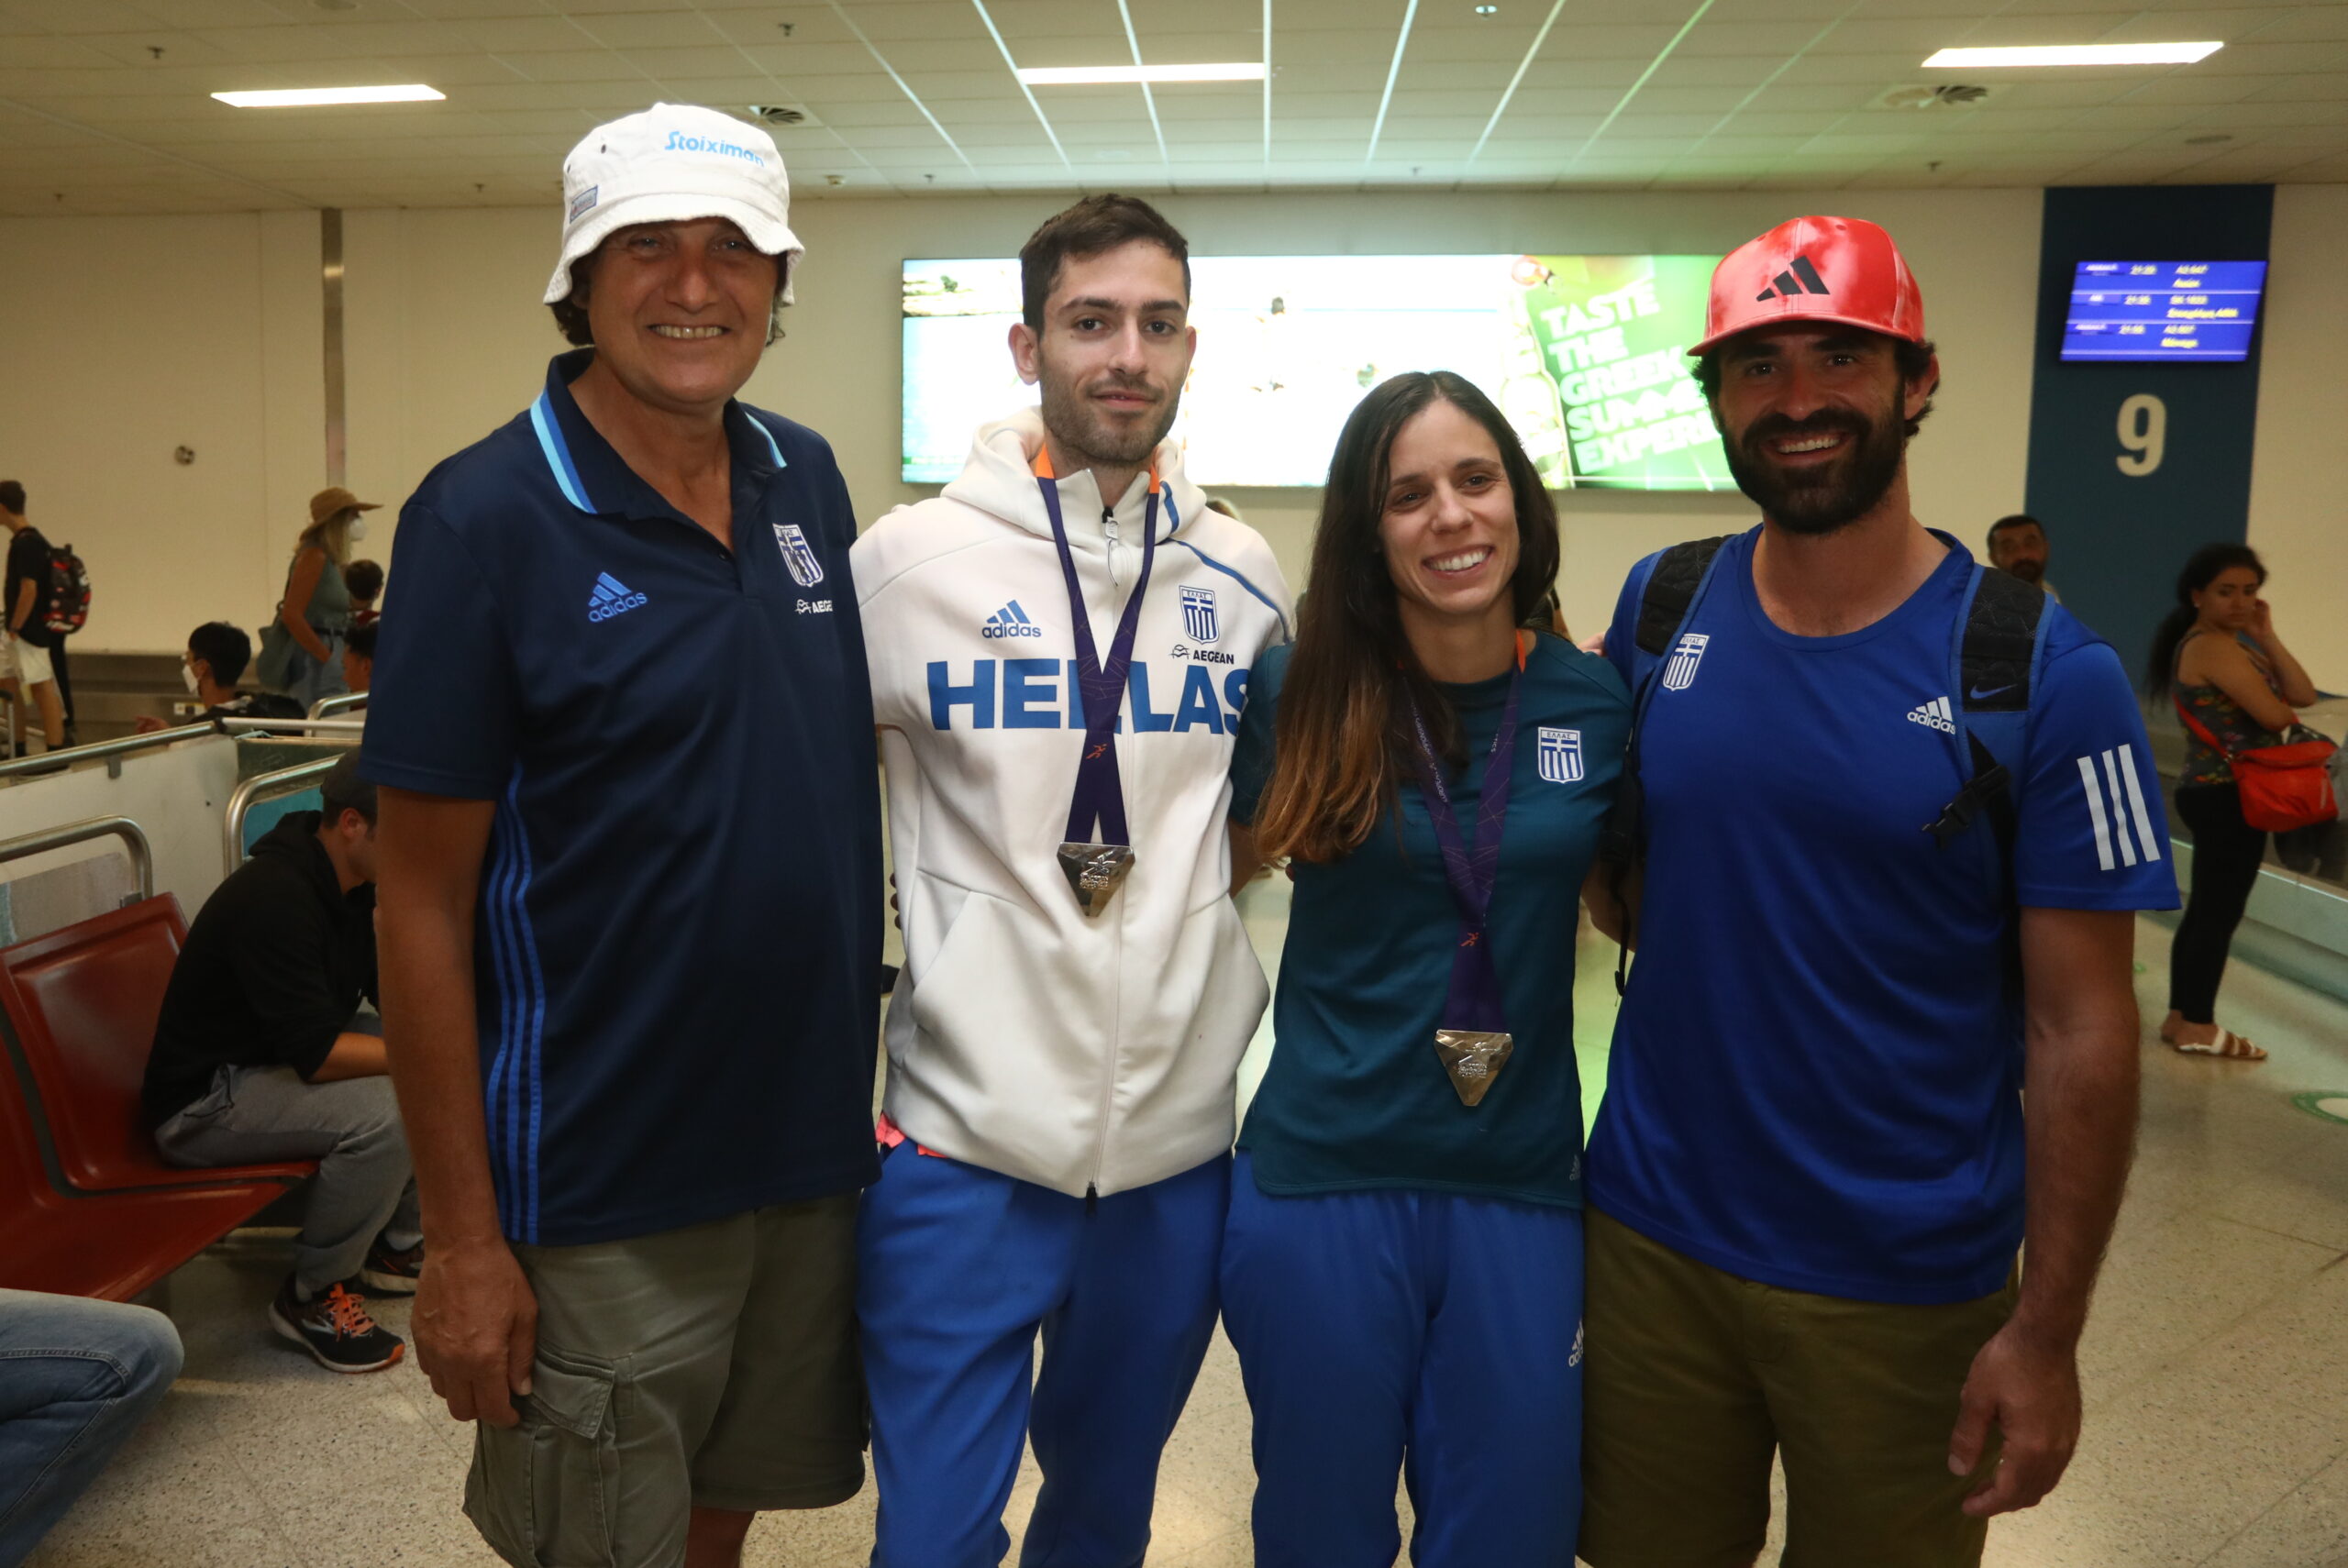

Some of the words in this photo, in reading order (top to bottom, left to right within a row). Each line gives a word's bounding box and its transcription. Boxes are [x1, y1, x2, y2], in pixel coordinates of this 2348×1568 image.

[665, 131, 764, 167] Stoiximan
[1540, 280, 1661, 339] TASTE
[1547, 326, 1628, 372] THE
[1559, 346, 1689, 406] GREEK
[2116, 393, 2166, 477] 9
[588, 591, 648, 622] adidas
[981, 621, 1041, 638] adidas
[1193, 650, 1235, 664] AEGEAN
[1907, 712, 1956, 734] adidas
